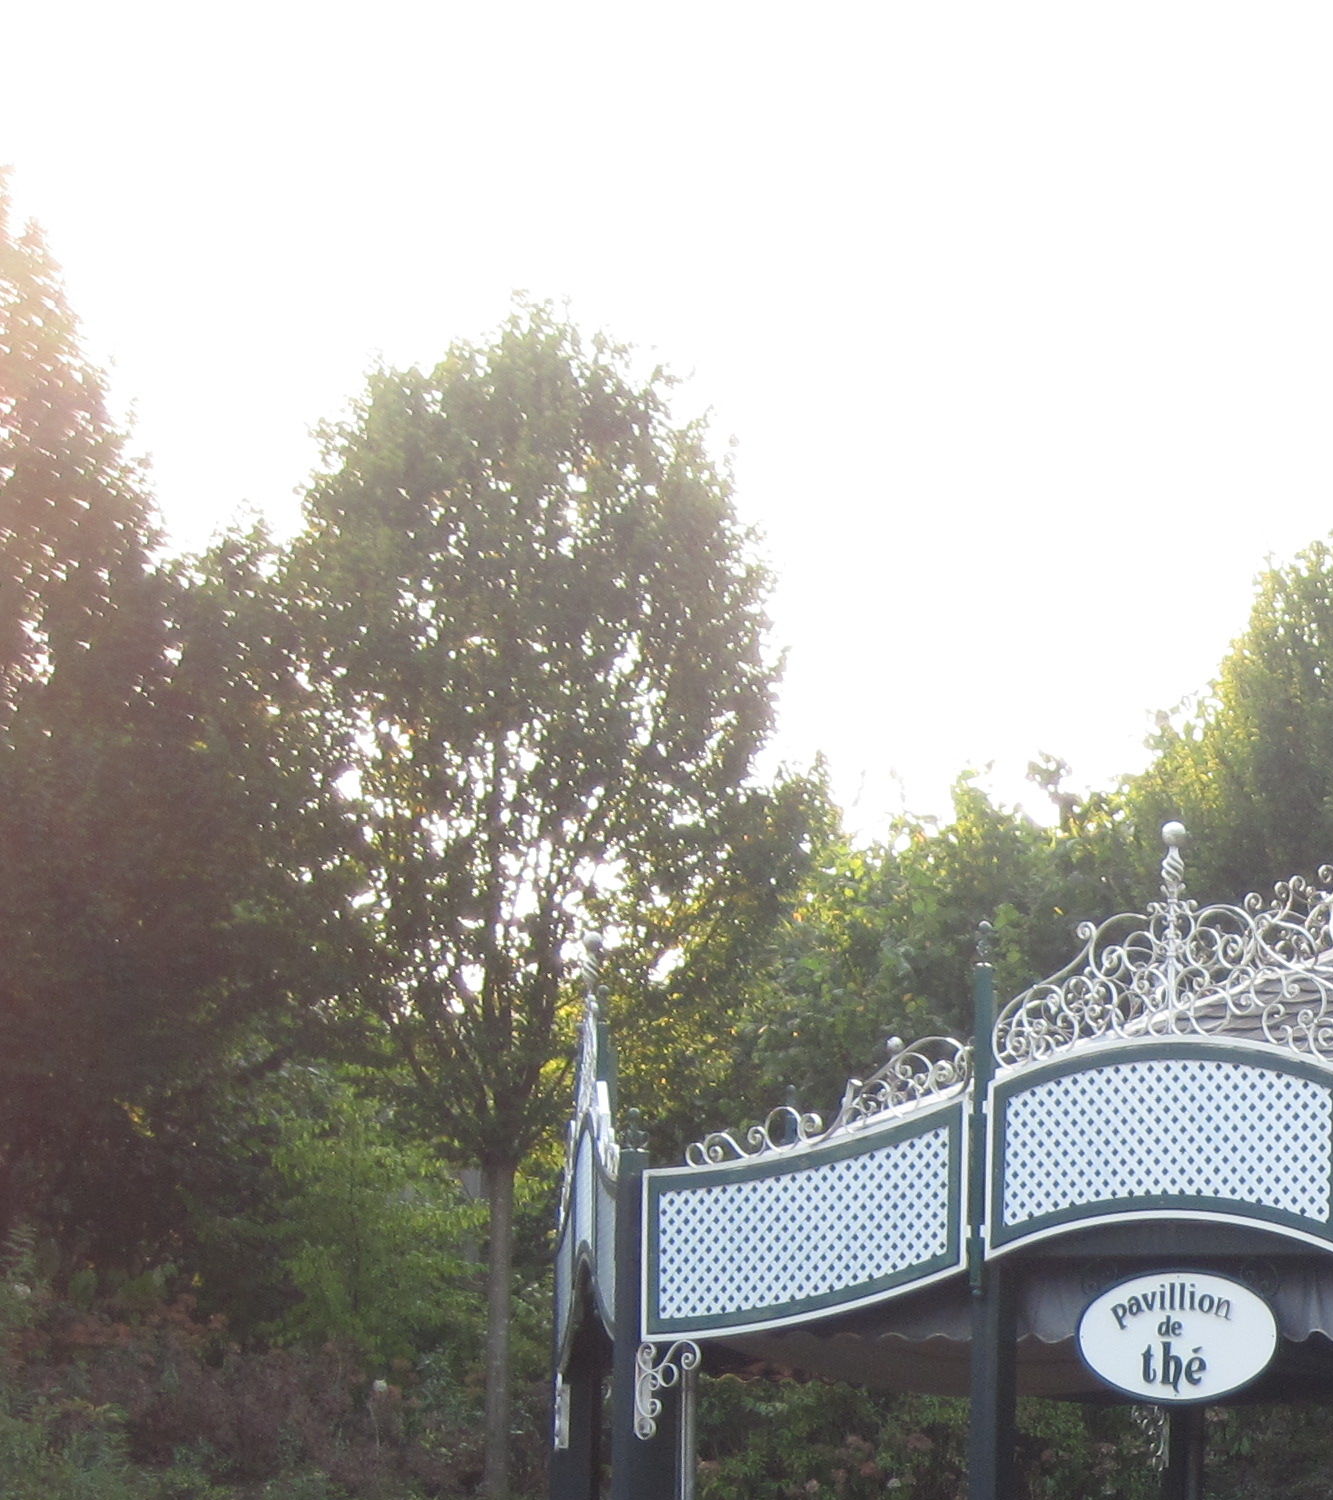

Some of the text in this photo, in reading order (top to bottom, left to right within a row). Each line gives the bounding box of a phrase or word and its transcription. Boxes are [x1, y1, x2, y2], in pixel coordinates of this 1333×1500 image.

[1111, 1282, 1233, 1330] pavillion
[1157, 1315, 1182, 1337] de
[1141, 1341, 1207, 1393] thé
